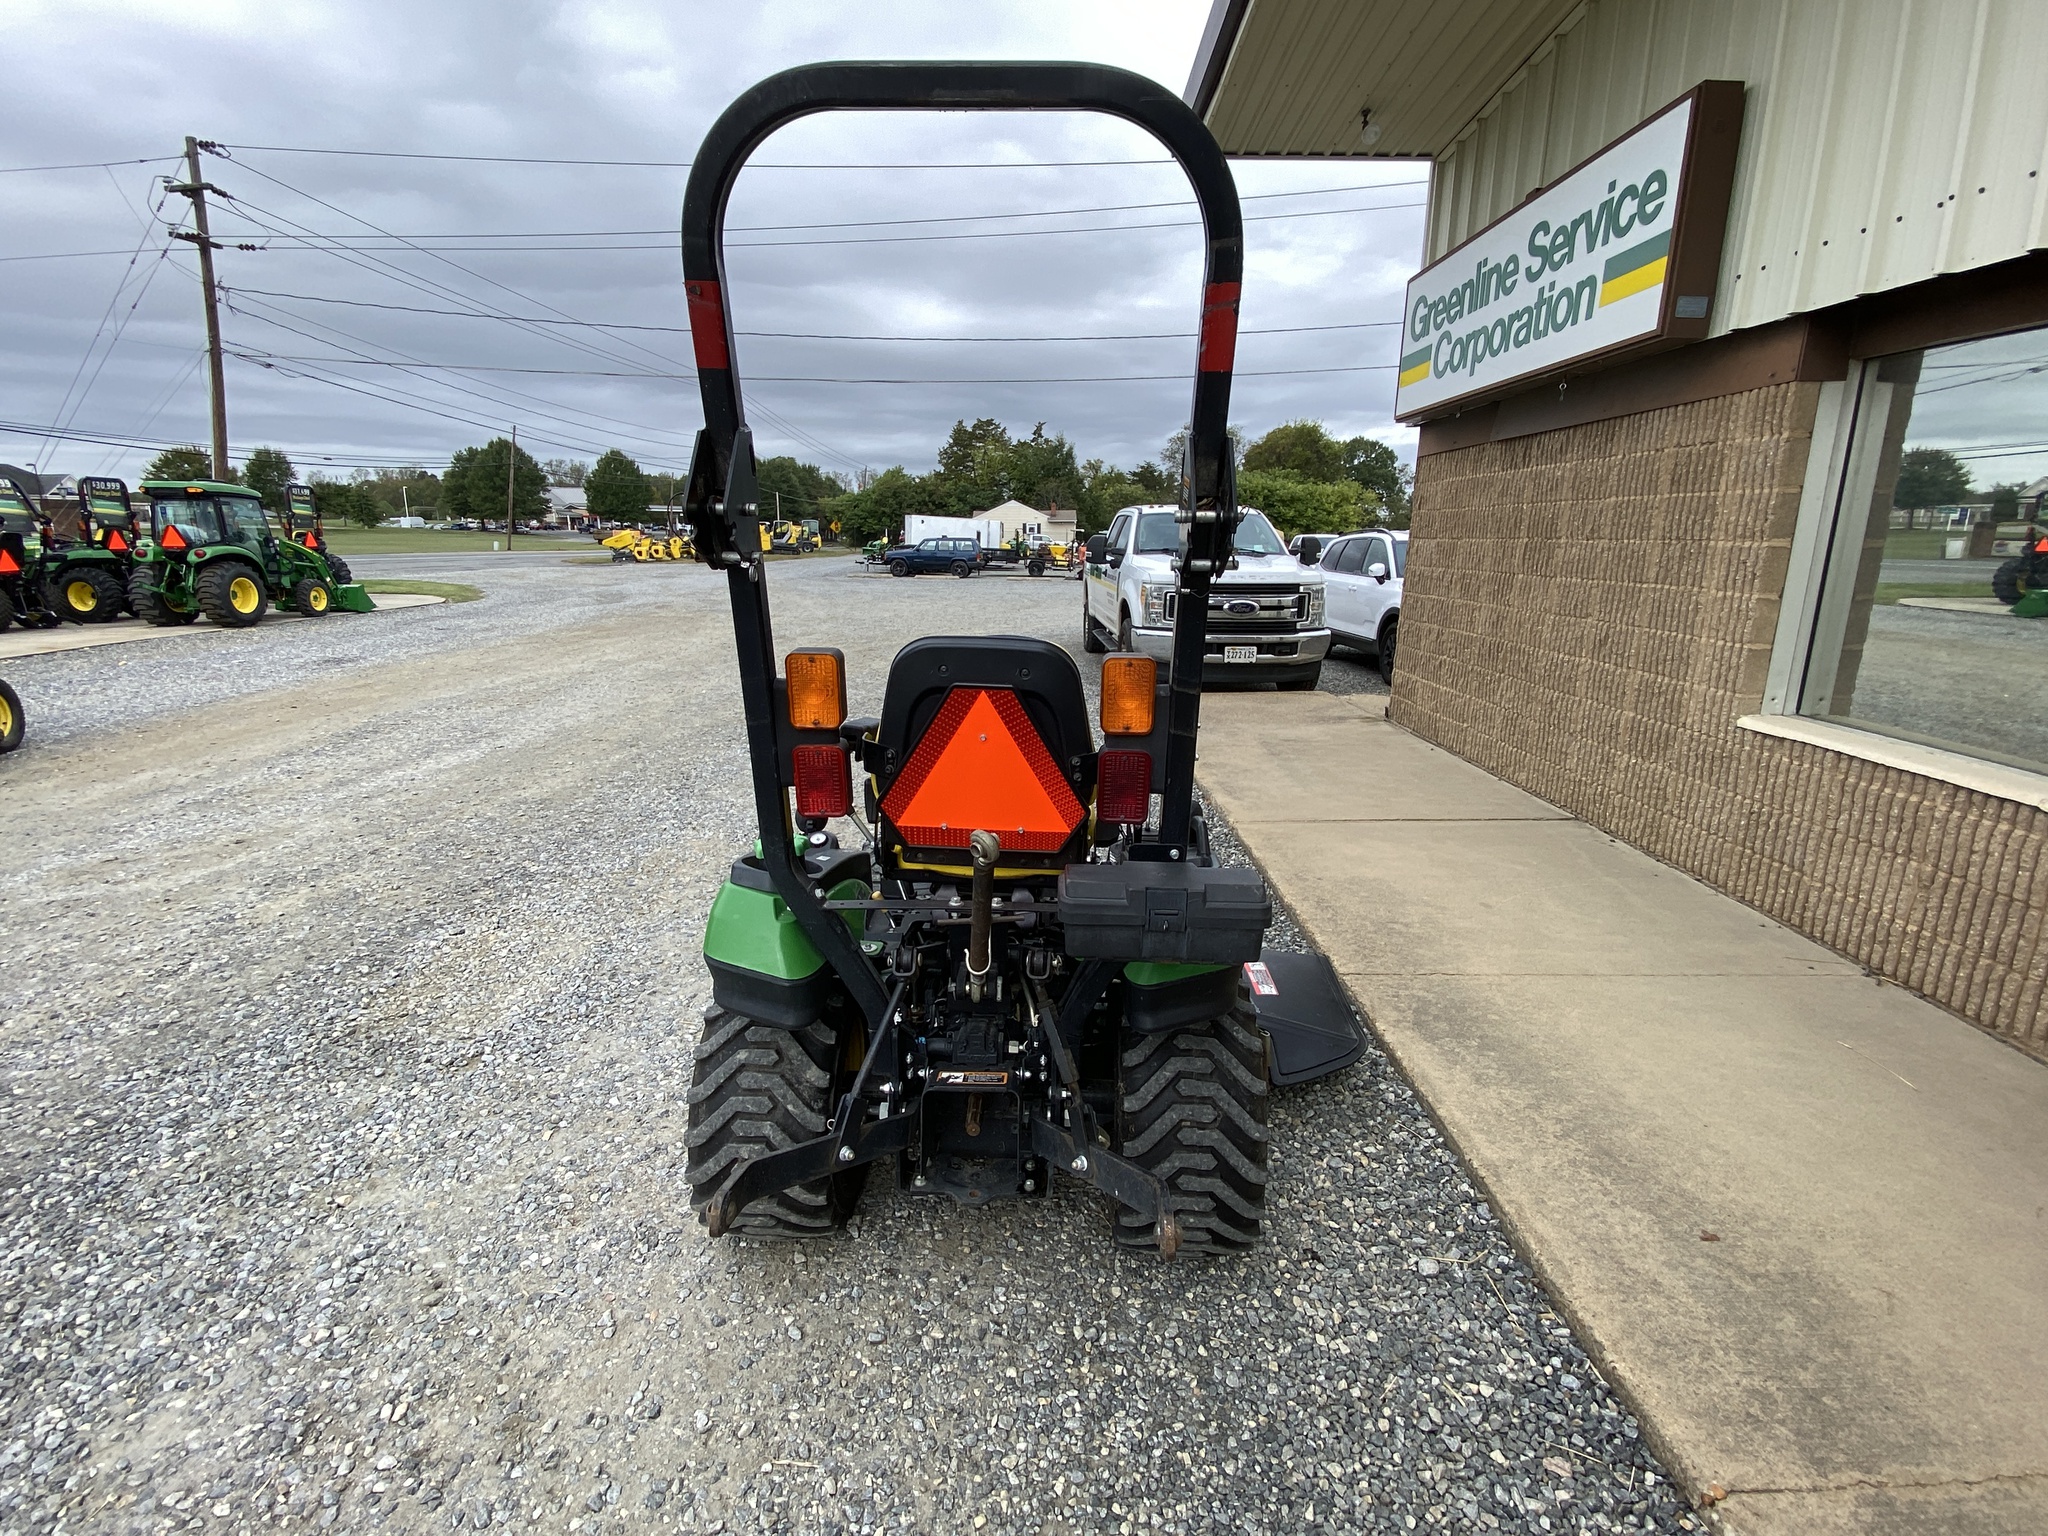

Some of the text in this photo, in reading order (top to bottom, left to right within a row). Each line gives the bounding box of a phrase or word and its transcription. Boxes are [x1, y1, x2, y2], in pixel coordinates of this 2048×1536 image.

[1410, 169, 1667, 342] Greenline Service
[1433, 274, 1597, 379] Corporation
[1233, 603, 1251, 613] Ford
